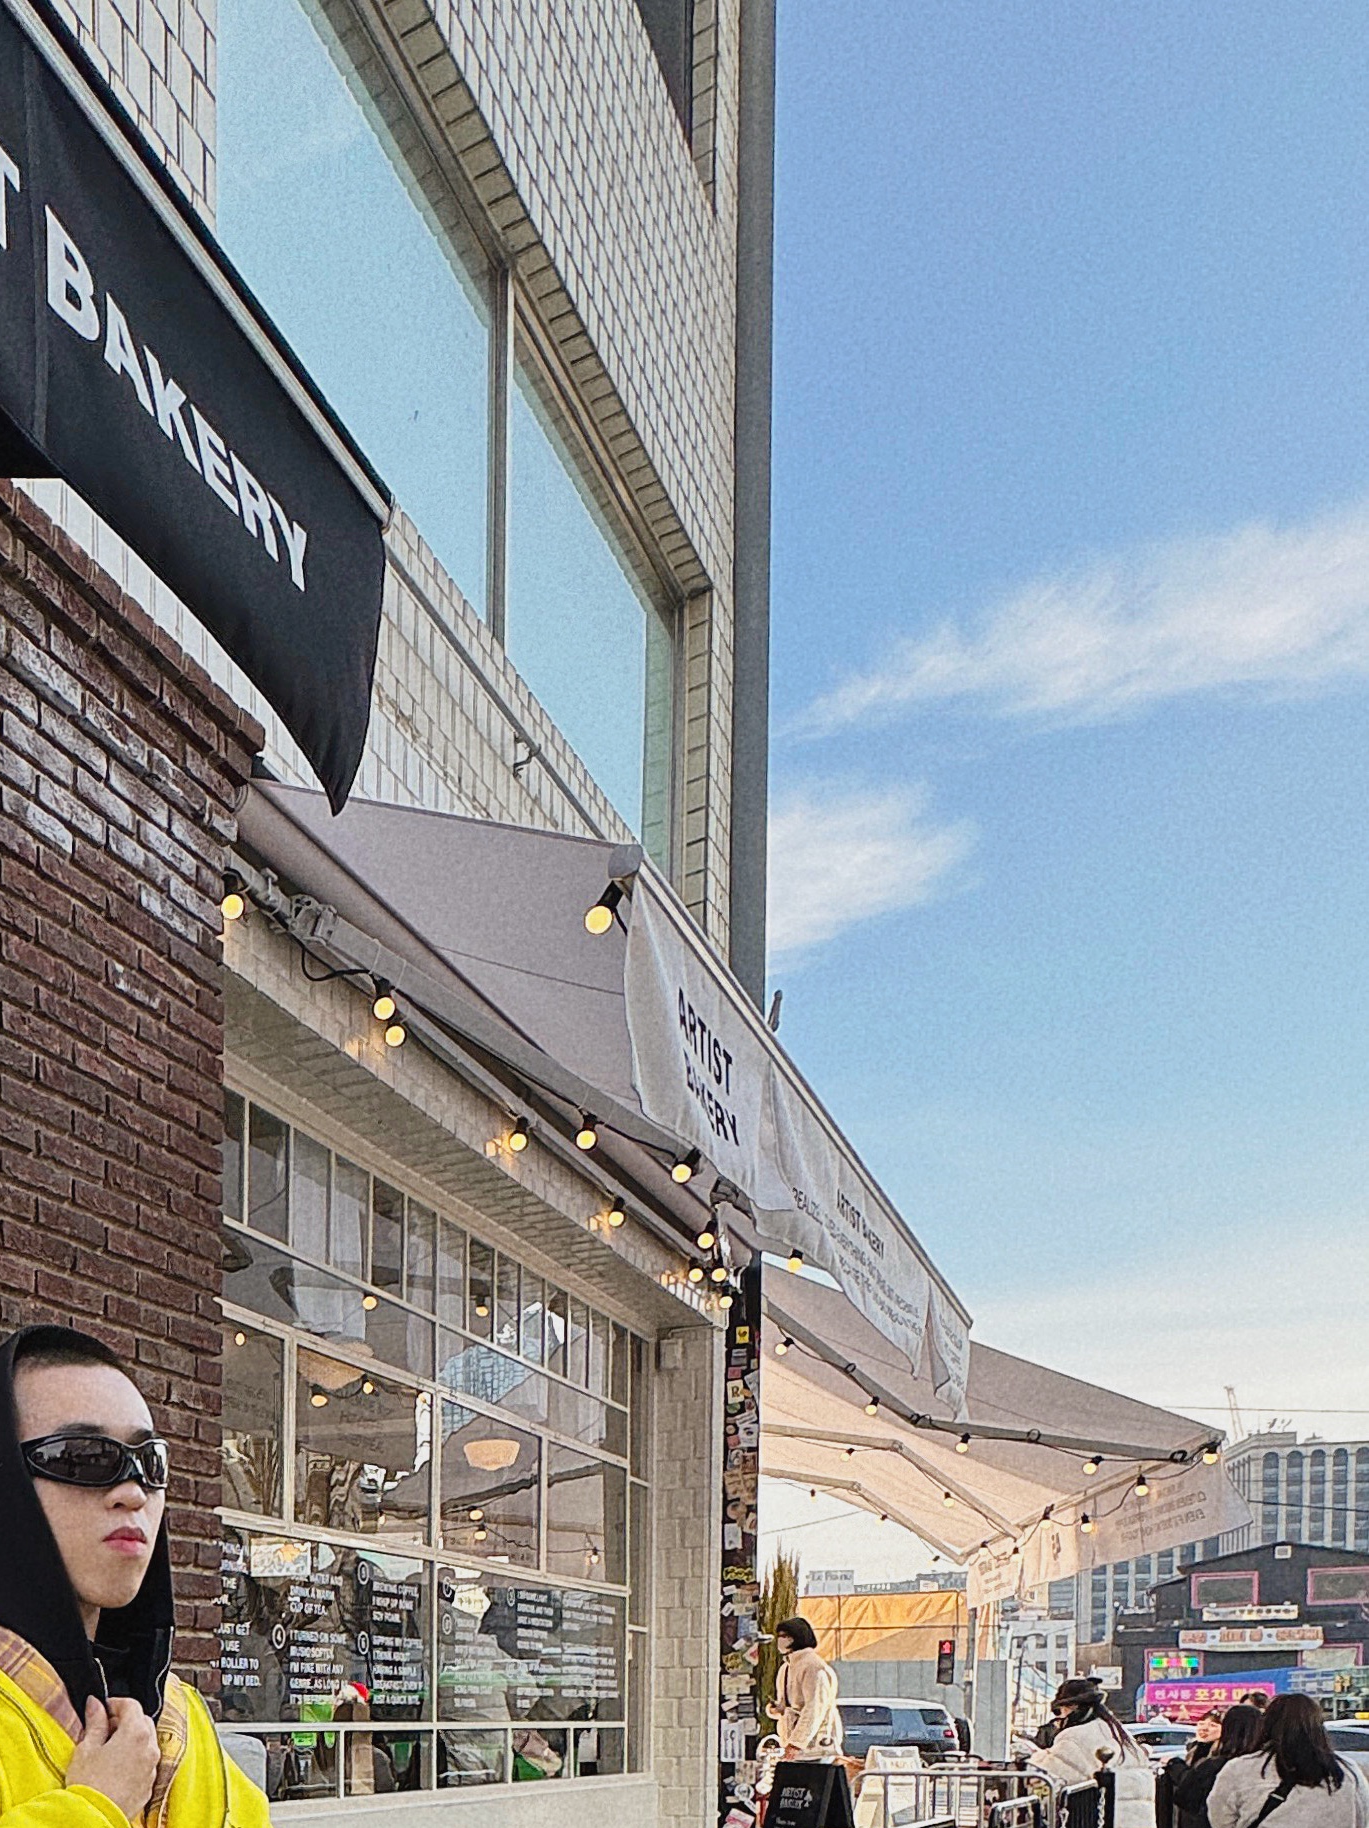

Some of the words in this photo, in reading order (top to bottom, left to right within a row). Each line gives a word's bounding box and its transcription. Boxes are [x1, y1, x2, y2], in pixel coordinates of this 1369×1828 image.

[44, 204, 308, 593] BAKERY
[678, 986, 733, 1096] ARTIST
[236, 1622, 250, 1636] GET
